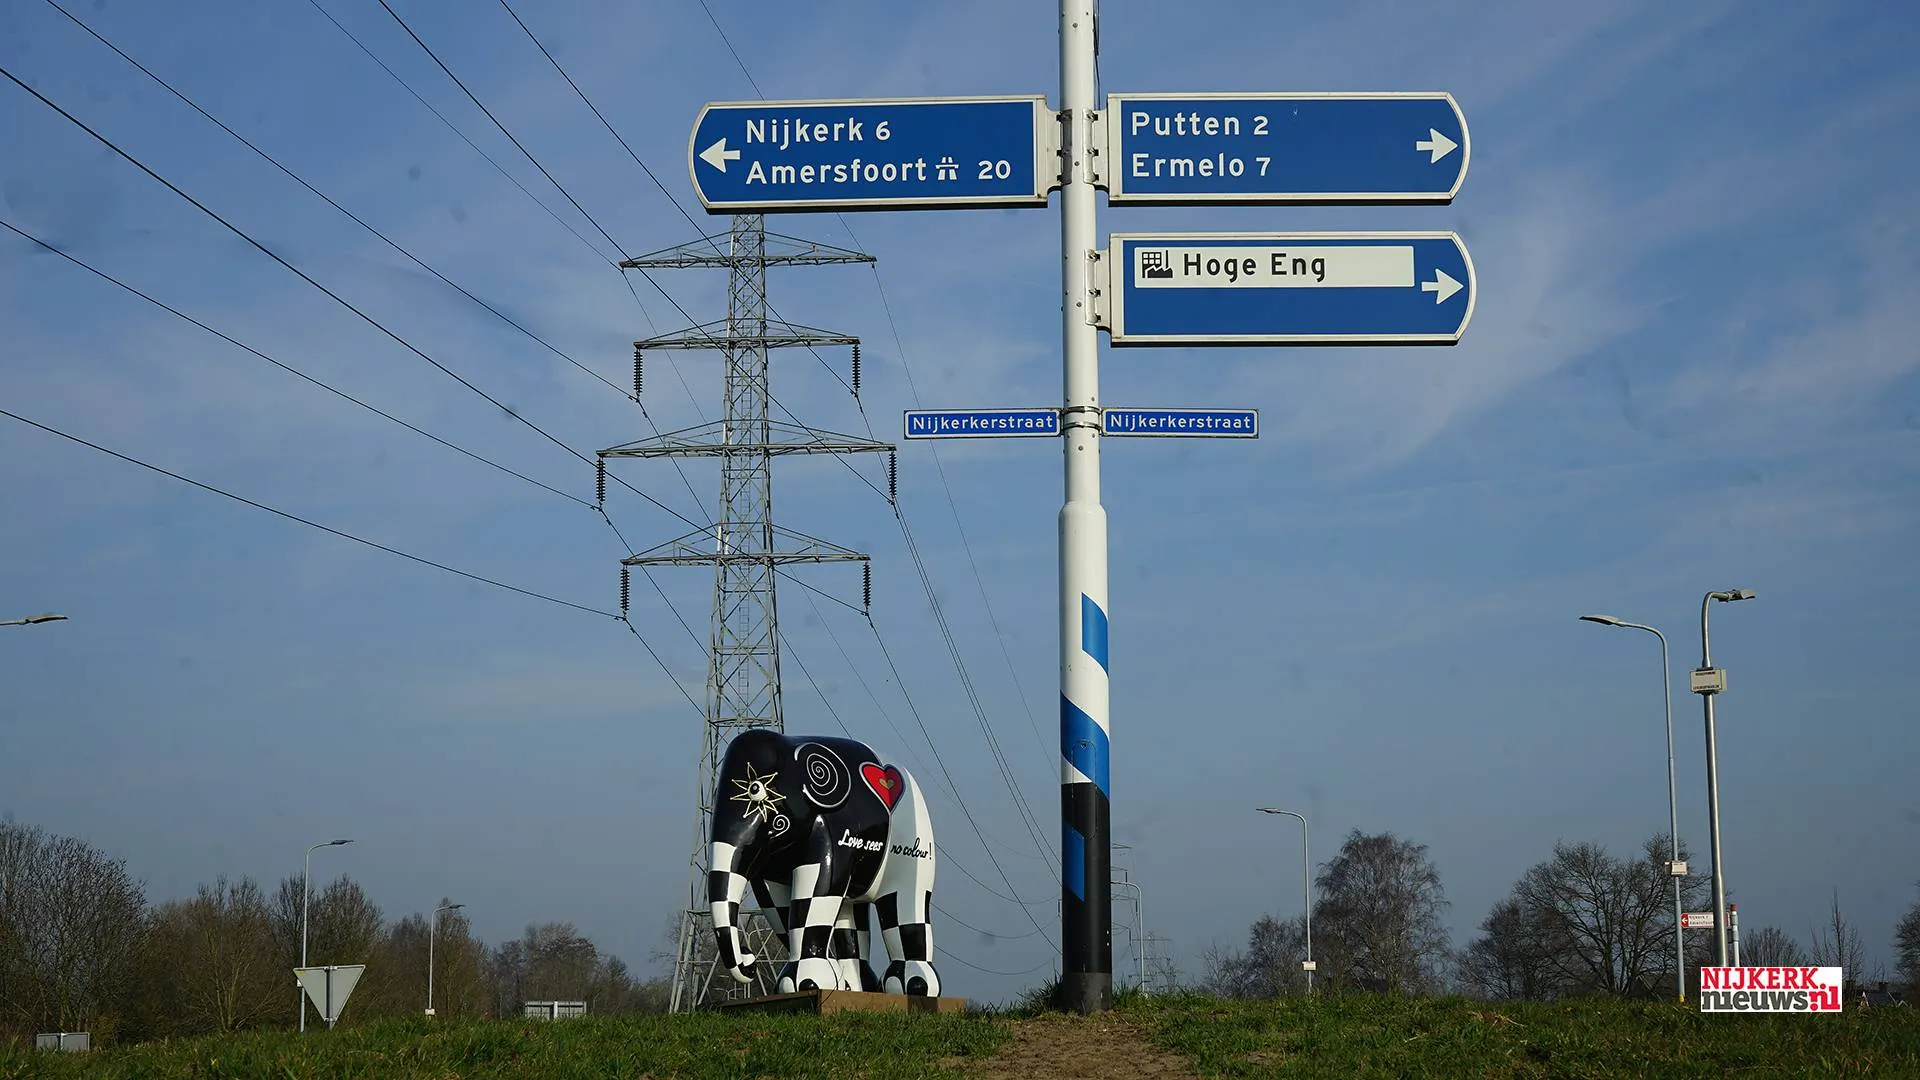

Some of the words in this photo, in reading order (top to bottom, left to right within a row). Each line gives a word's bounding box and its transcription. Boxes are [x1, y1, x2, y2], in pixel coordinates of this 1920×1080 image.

[745, 118, 864, 150] Nijkerk
[875, 120, 891, 142] 6
[1131, 112, 1240, 136] Putten
[1253, 115, 1269, 136] 2
[745, 157, 927, 185] Amersfoort
[978, 159, 1011, 180] 20
[1131, 153, 1245, 177] Ermelo
[1255, 157, 1271, 177] 7
[1183, 253, 1257, 283] Hoge
[1271, 253, 1326, 282] Eng
[912, 414, 1054, 433] Nijkerkerstraat
[1110, 414, 1252, 432] Nijkerkerstraat
[837, 828, 864, 849] Love
[863, 839, 883, 852] sees
[890, 843, 902, 856] no
